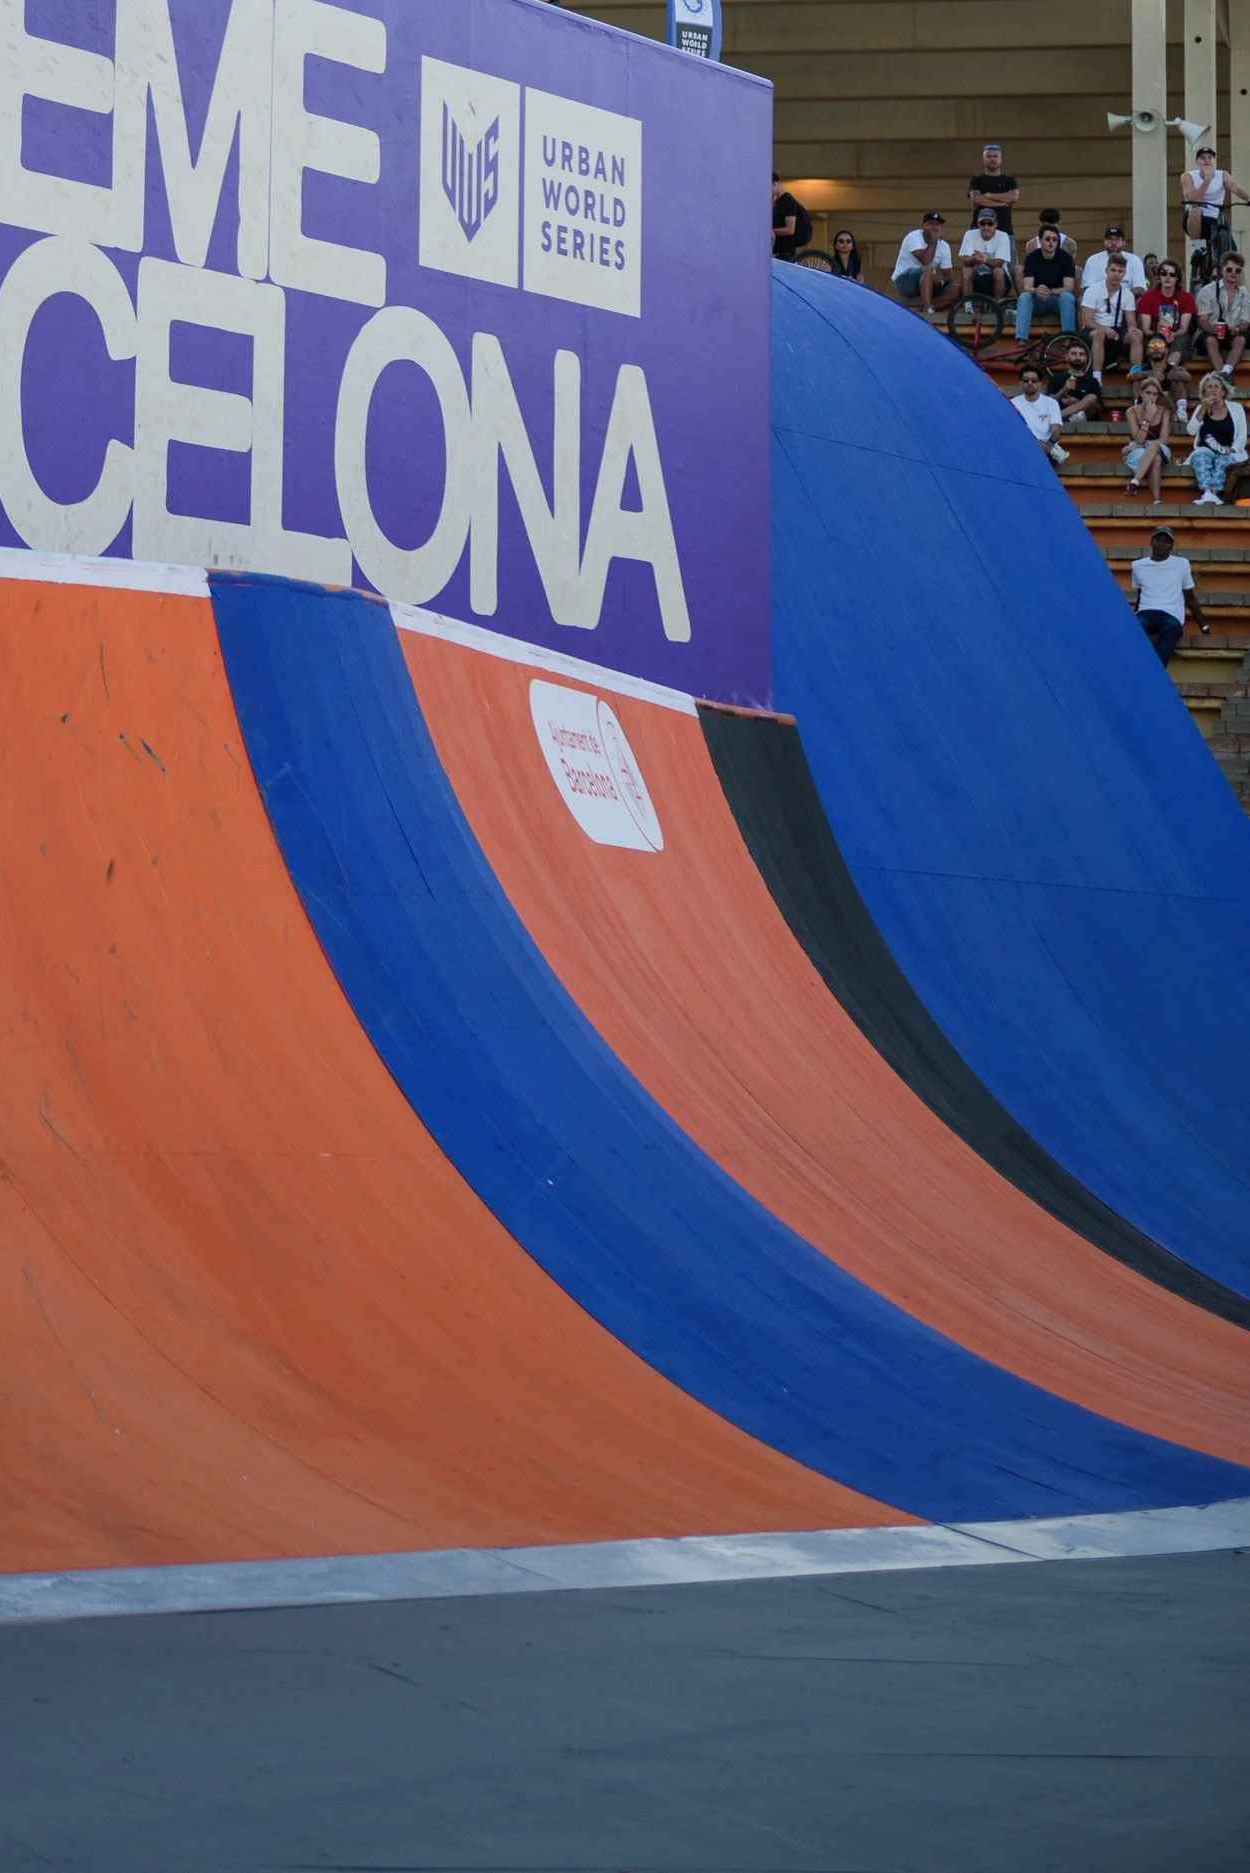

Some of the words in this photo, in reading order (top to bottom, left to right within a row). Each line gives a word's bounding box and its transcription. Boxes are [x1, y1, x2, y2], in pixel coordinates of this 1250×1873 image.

[681, 30, 708, 42] URBAN
[681, 38, 707, 50] WORLD
[542, 134, 626, 187] URBAN
[541, 177, 626, 226] WORLD
[540, 221, 626, 271] SERIES
